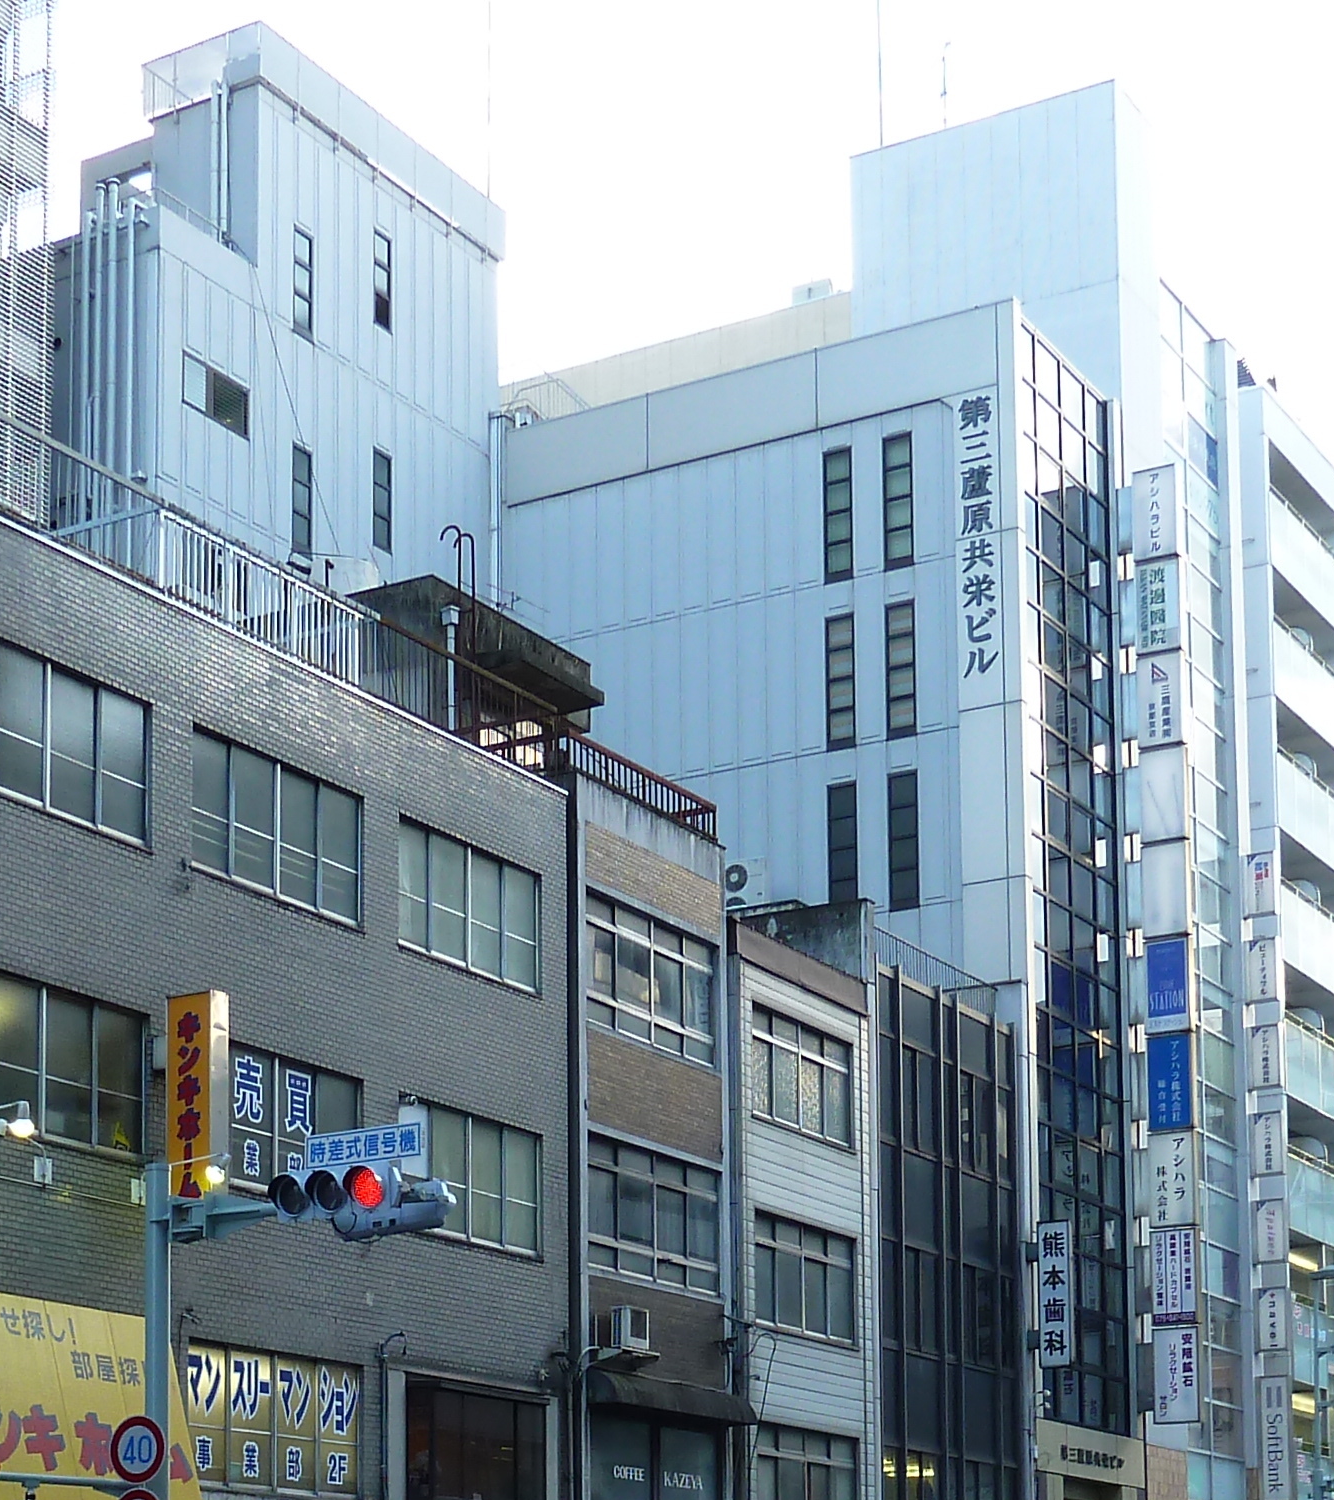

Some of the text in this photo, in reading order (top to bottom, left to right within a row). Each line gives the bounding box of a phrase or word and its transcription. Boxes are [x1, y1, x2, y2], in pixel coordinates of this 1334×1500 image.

[1149, 474, 1161, 552] アシハラビル
[1150, 990, 1184, 1011] STATION
[176, 1011, 202, 1199] キンキホーム
[234, 1055, 314, 1137] 売買
[308, 1126, 418, 1166] 時差式信号機
[1173, 1137, 1186, 1201] アシハラ
[1156, 1166, 1168, 1222] 株式会社
[1042, 1231, 1067, 1356] 熊本歯科
[70, 1350, 146, 1386] 部屋探
[188, 1352, 359, 1438] マンスリーマンション
[122, 1435, 154, 1465] 40
[327, 1452, 348, 1486] 2F
[614, 1465, 703, 1490] COFFEE KAZEYA
[1267, 1413, 1284, 1493] SoftBank
